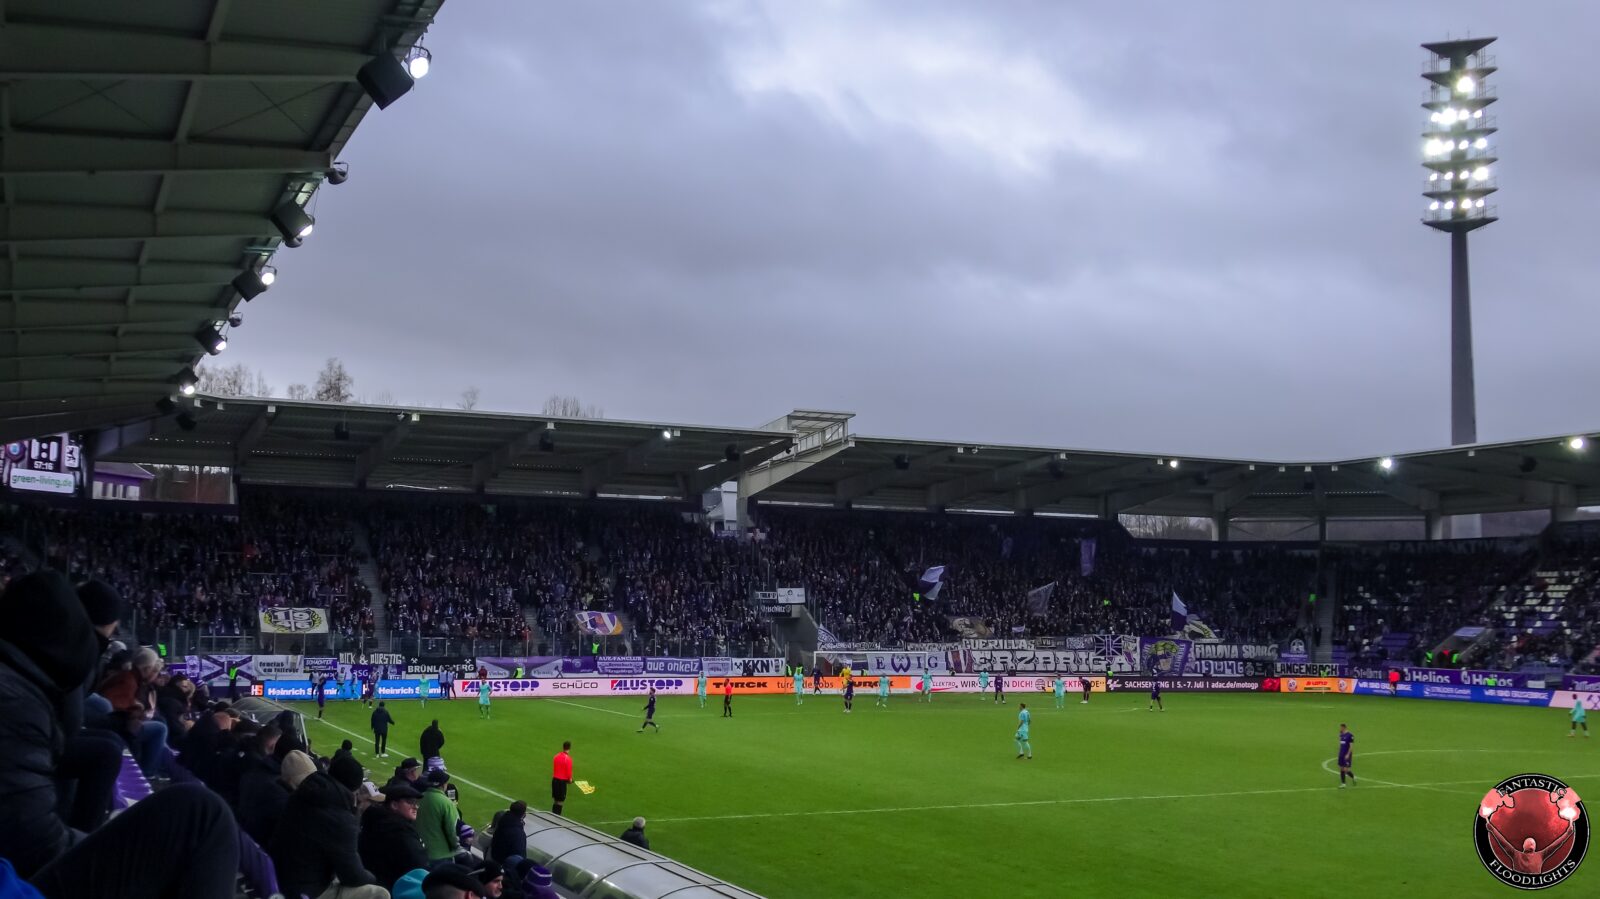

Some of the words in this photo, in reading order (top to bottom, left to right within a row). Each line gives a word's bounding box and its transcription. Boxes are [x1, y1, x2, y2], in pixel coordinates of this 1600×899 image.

[1413, 671, 1450, 683] Helios
[552, 680, 599, 690] SCHÜCO
[1211, 681, 1259, 690] adac.de/motogp
[268, 687, 305, 695] Heinrich
[378, 686, 413, 695] Heinrich
